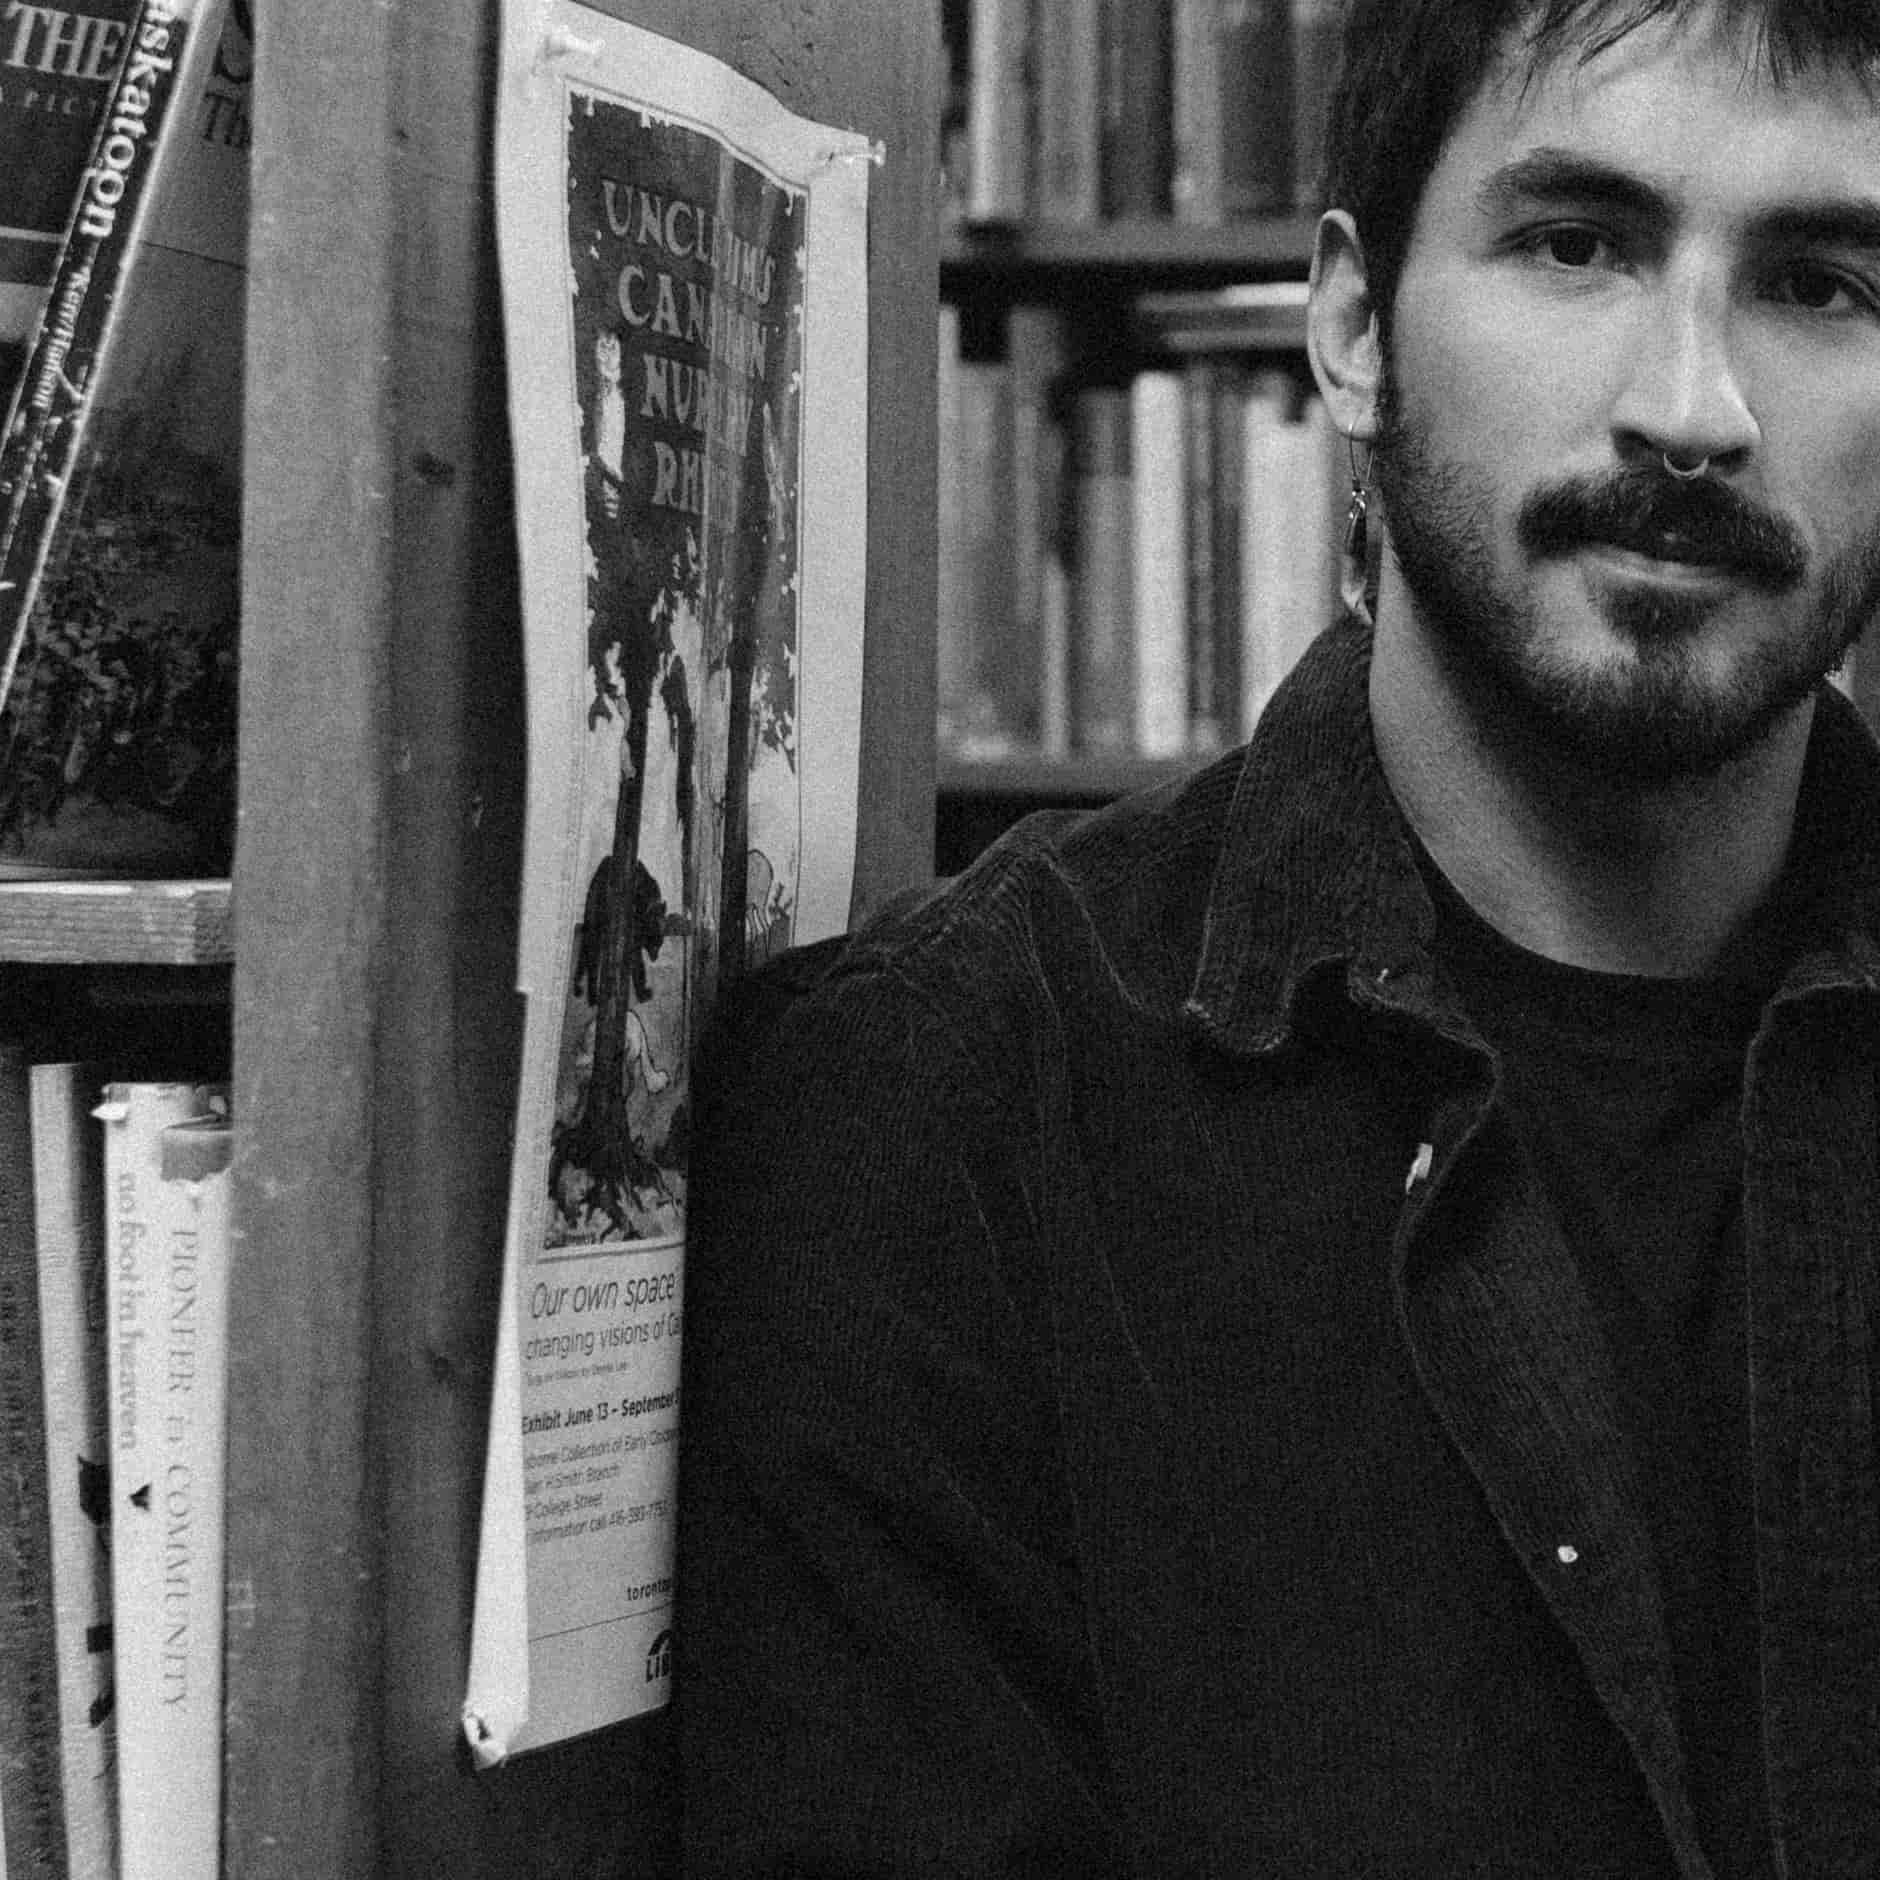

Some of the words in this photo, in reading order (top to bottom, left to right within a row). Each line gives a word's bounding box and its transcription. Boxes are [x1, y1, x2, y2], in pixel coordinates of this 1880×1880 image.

[4, 0, 127, 81] THE
[116, 1172, 137, 1214] no
[116, 1220, 146, 1284] foot
[116, 1290, 145, 1317] in
[166, 1229, 199, 1393] PIONEER
[532, 1281, 570, 1319] Our
[573, 1280, 620, 1313] own
[624, 1272, 676, 1313] space
[525, 1326, 595, 1361] changing
[599, 1322, 650, 1348] visions
[116, 1330, 144, 1451] heaven
[522, 1410, 562, 1436] Exhibit
[564, 1406, 594, 1428] June
[596, 1401, 609, 1421] 13
[621, 1392, 676, 1418] September
[163, 1464, 195, 1714] COMMUNITY
